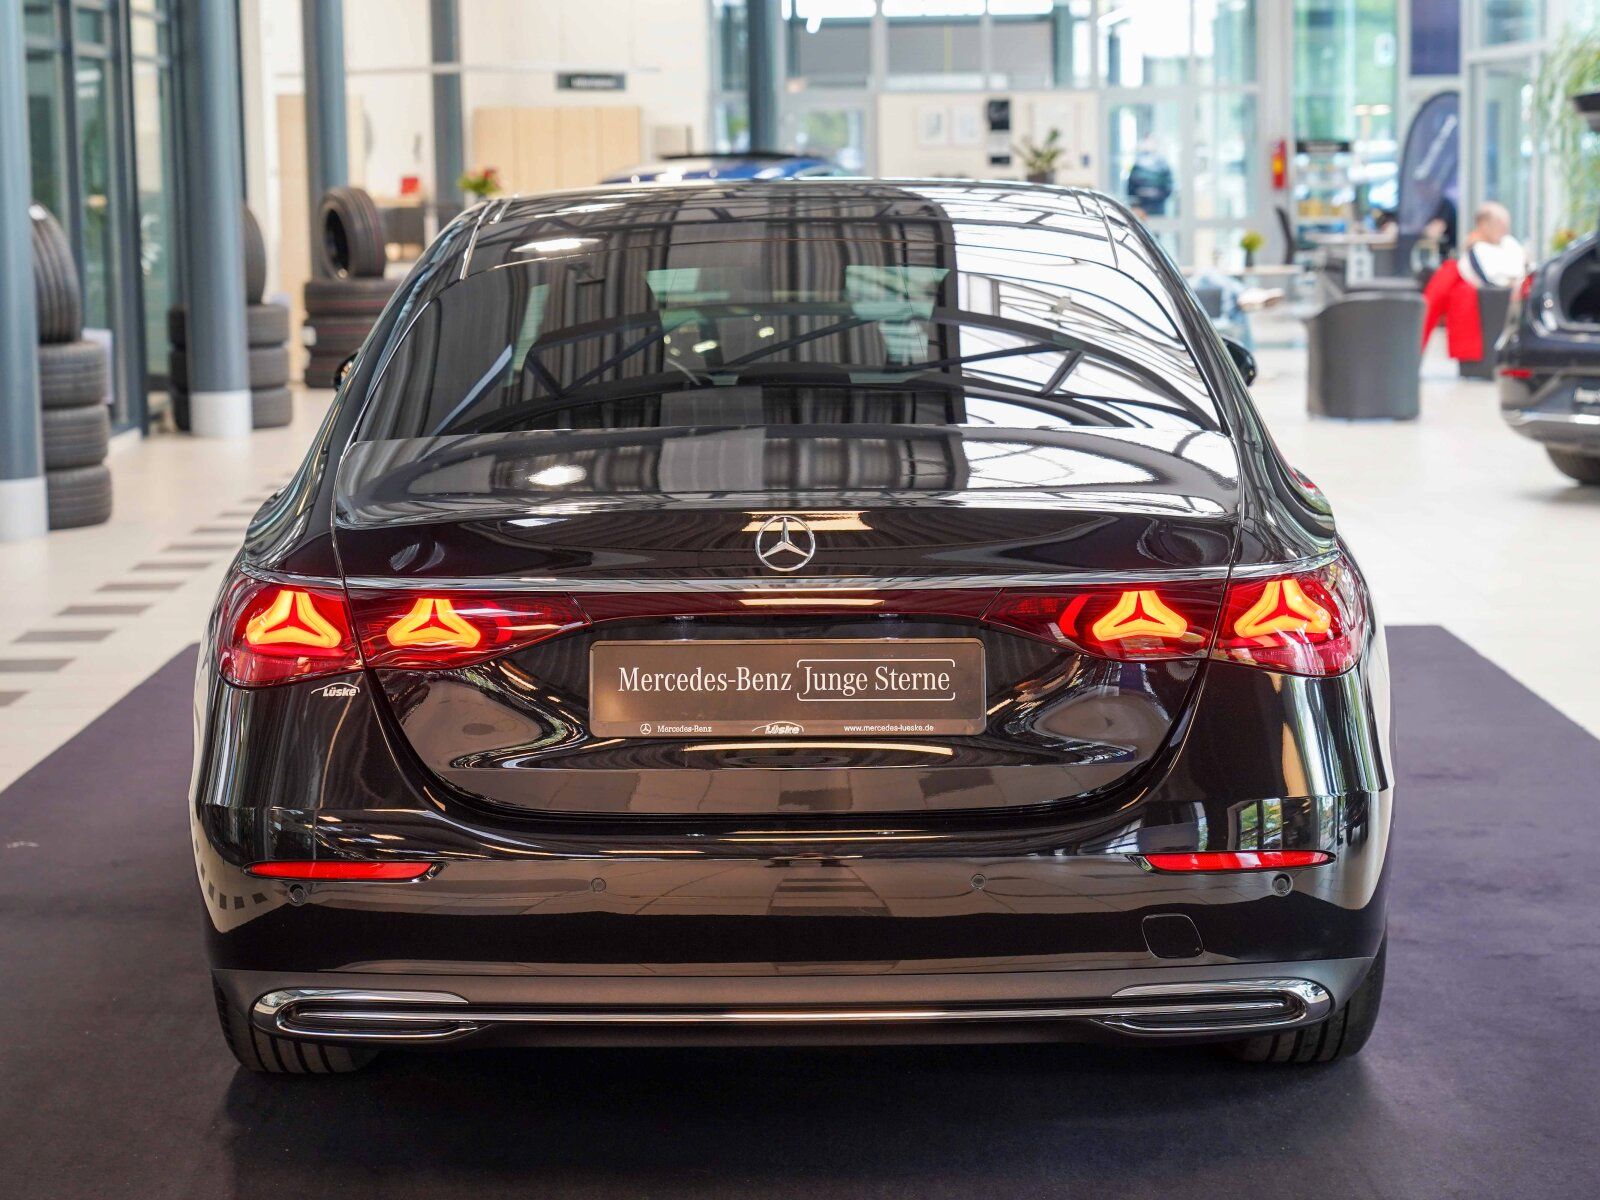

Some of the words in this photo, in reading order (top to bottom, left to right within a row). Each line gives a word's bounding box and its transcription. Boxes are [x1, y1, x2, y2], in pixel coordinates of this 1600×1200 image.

[617, 666, 792, 692] Mercedes-Benz
[803, 666, 868, 697] Junge
[875, 665, 950, 691] Sterne
[322, 686, 357, 697] Lüske
[657, 724, 713, 733] Mercedes-Benz
[843, 724, 935, 732] www.mercedes-lueske.de
